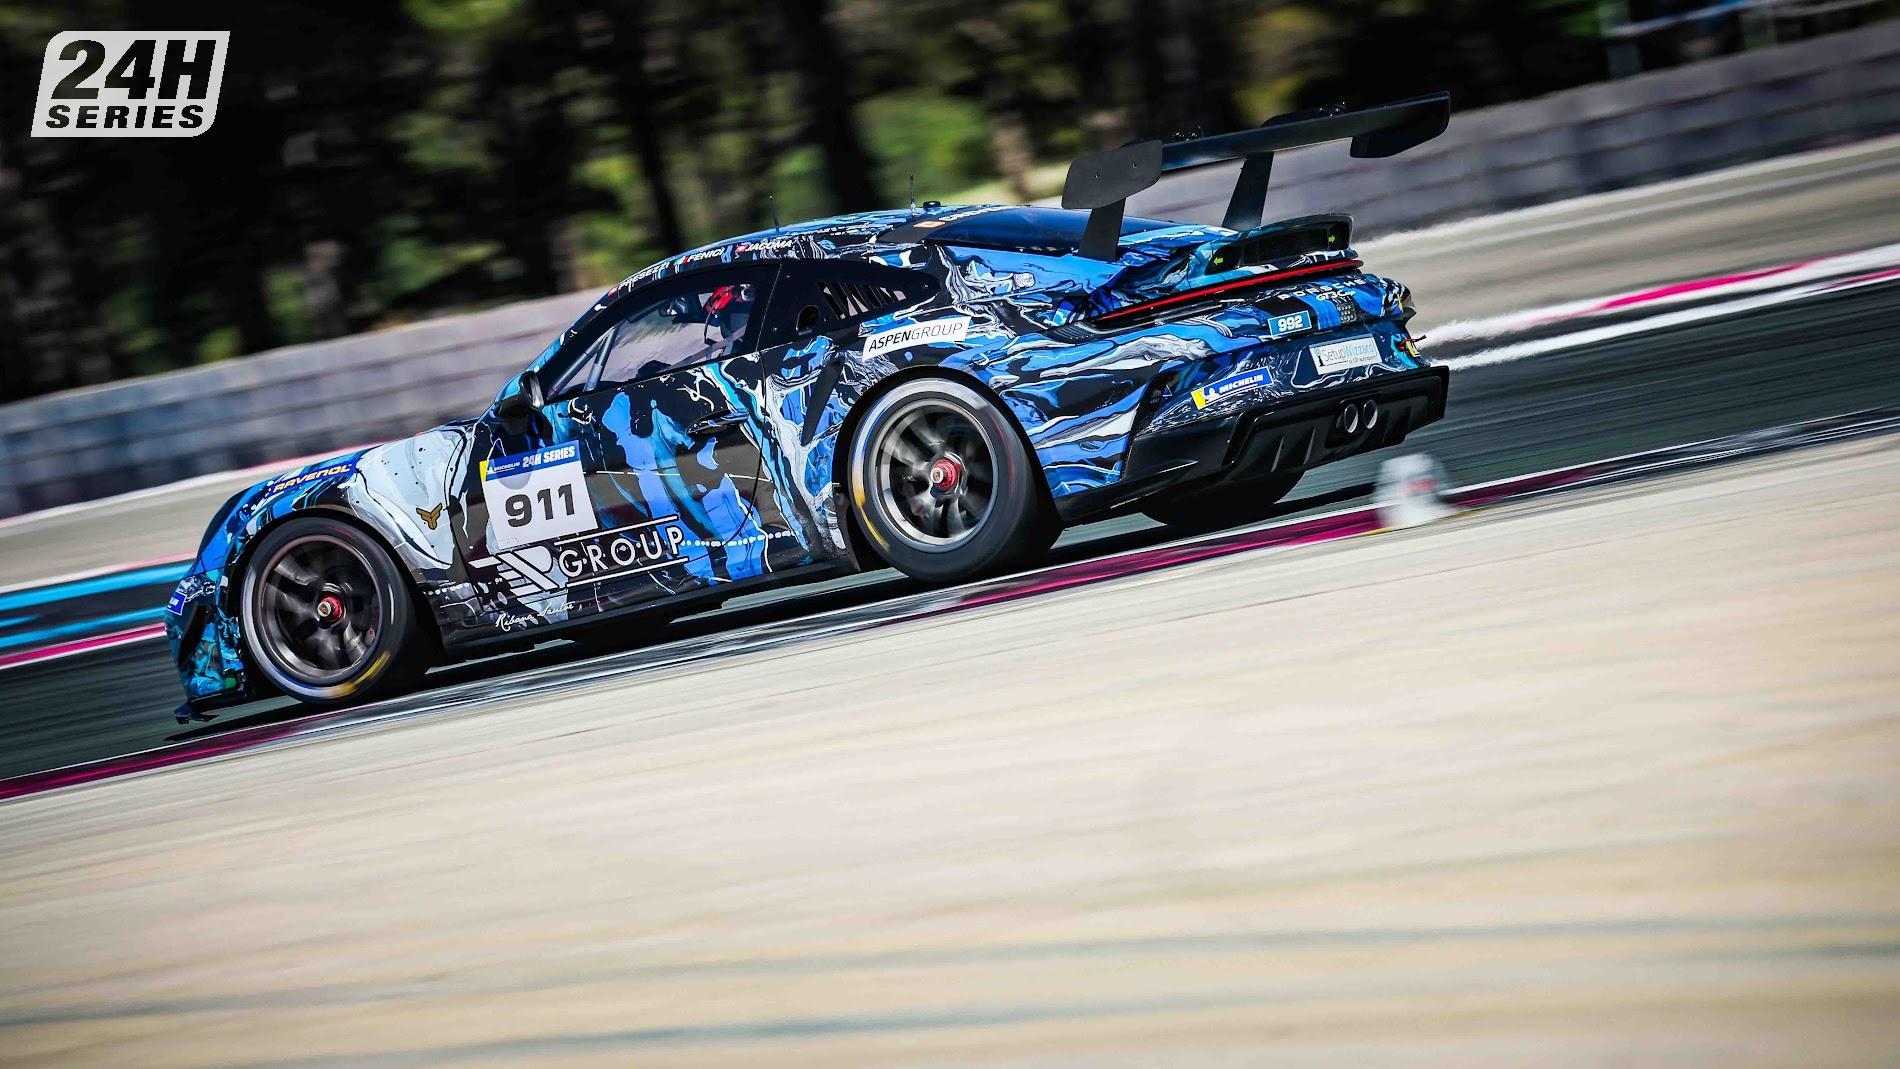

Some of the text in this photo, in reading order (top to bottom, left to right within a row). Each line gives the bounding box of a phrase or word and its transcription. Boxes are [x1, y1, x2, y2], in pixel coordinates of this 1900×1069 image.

[687, 248, 725, 263] FENICI
[745, 239, 792, 252] JACOMA
[1278, 279, 1366, 301] PORSCHE
[1278, 315, 1303, 332] 992
[1219, 374, 1264, 393] MICHELIN
[494, 445, 575, 472] MICHELIN 24H SERIES
[273, 464, 352, 493] RAVENOL
[505, 483, 575, 528] 911
[558, 526, 683, 577] GROUP
